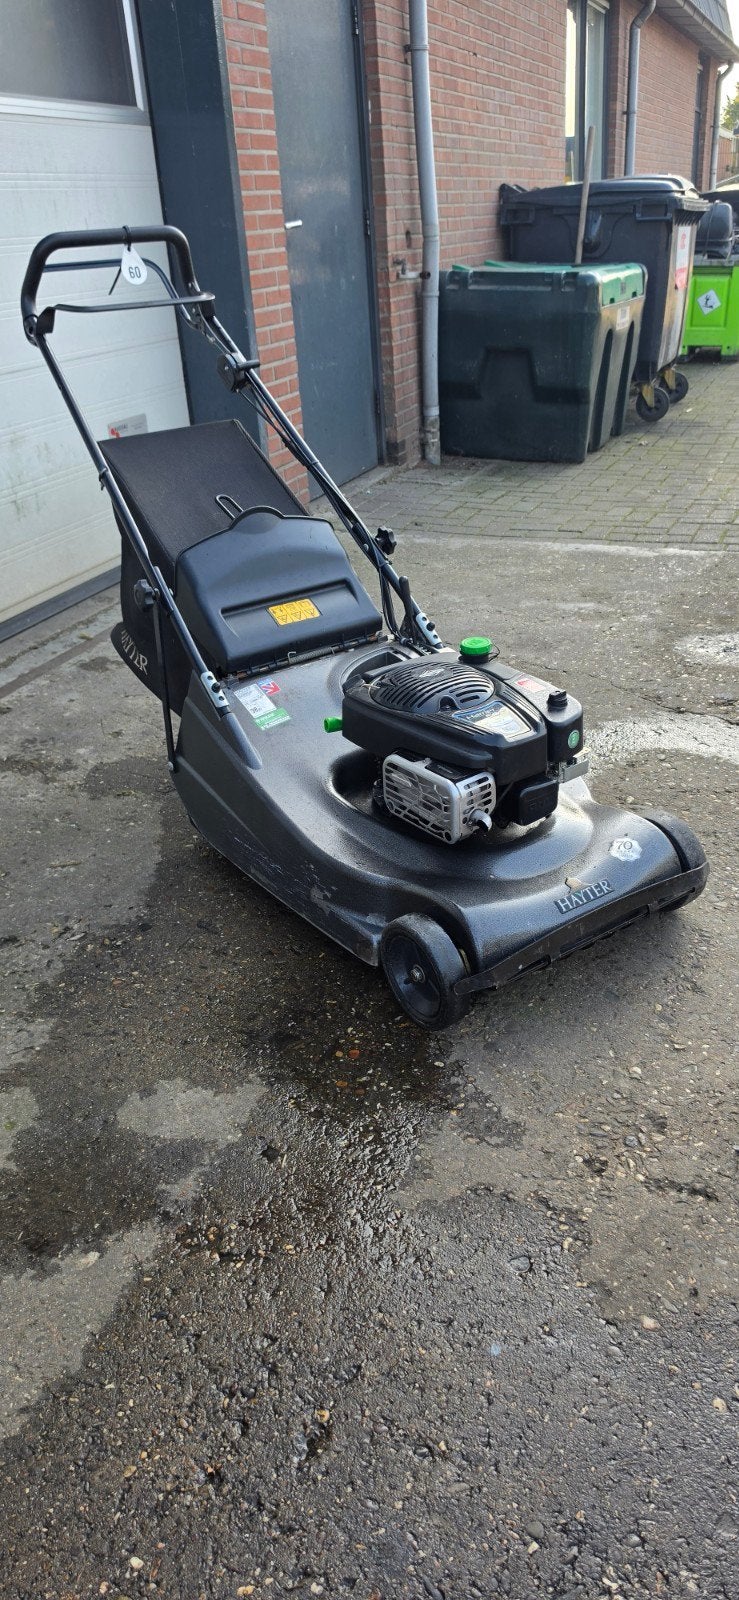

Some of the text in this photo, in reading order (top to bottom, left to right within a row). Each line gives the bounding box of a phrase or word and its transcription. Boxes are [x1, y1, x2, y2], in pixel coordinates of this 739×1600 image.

[128, 266, 142, 279] 60
[616, 840, 634, 851] 70
[557, 880, 613, 912] HAYTER
